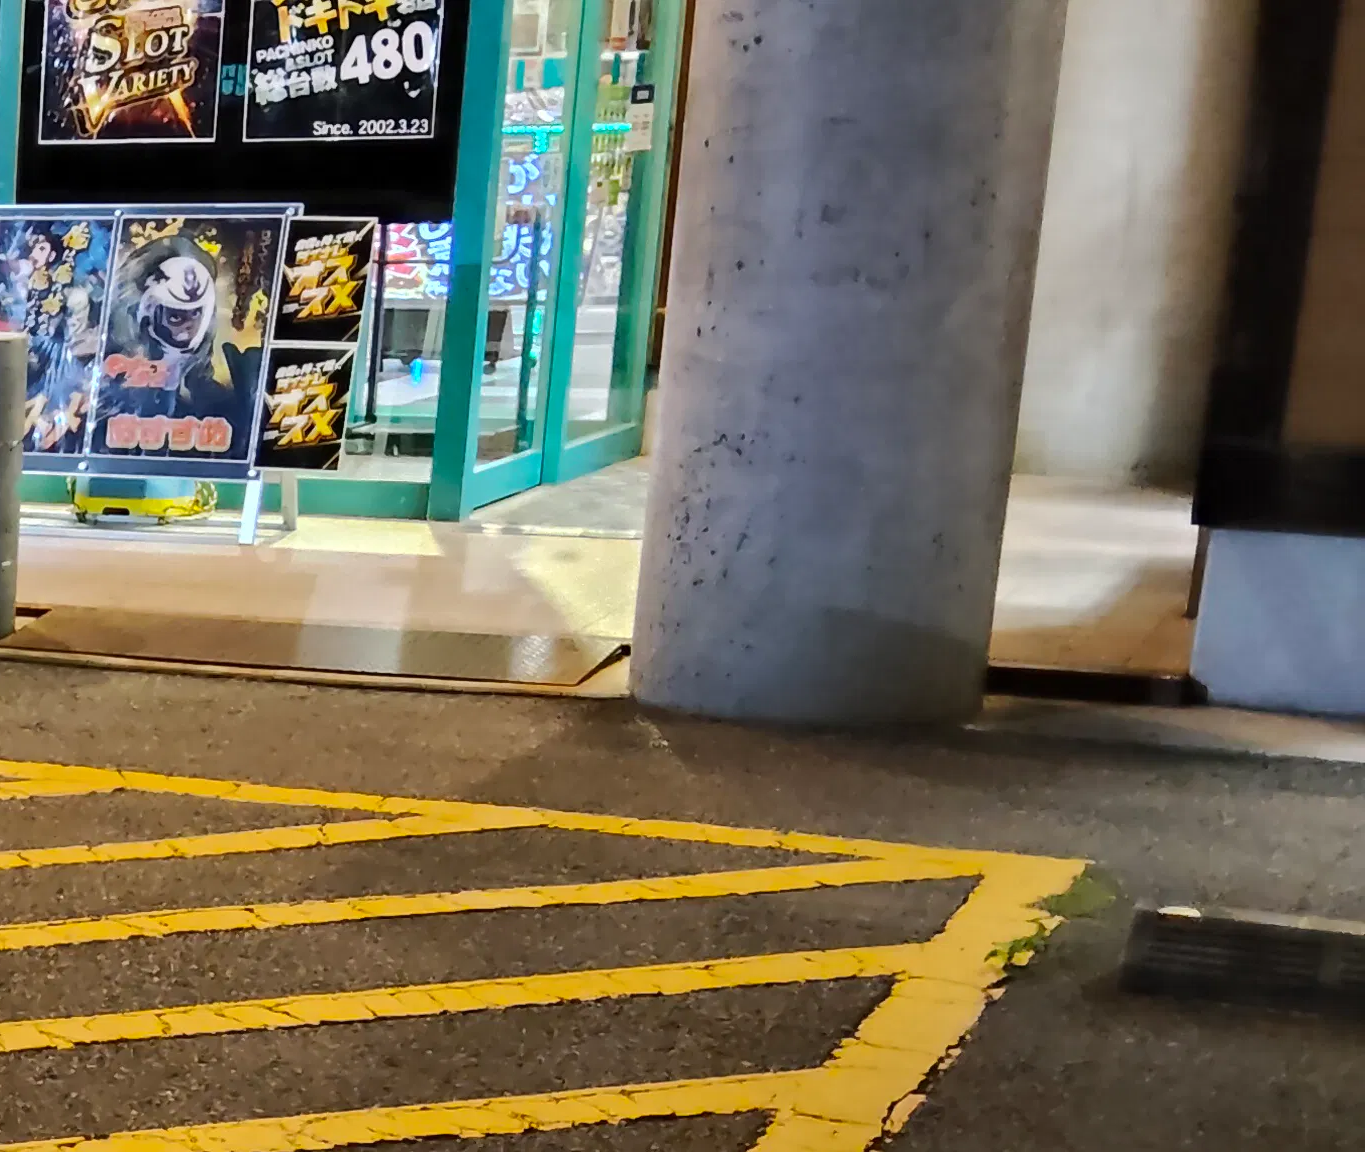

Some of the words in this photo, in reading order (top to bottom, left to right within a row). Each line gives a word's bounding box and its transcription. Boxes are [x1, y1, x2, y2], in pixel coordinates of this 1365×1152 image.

[85, 15, 189, 74] SLOT
[256, 34, 334, 63] PACHINKO
[340, 20, 436, 84] 480
[78, 63, 193, 126] VARIETY
[313, 121, 353, 135] Since.
[358, 119, 429, 134] 2002.3.23
